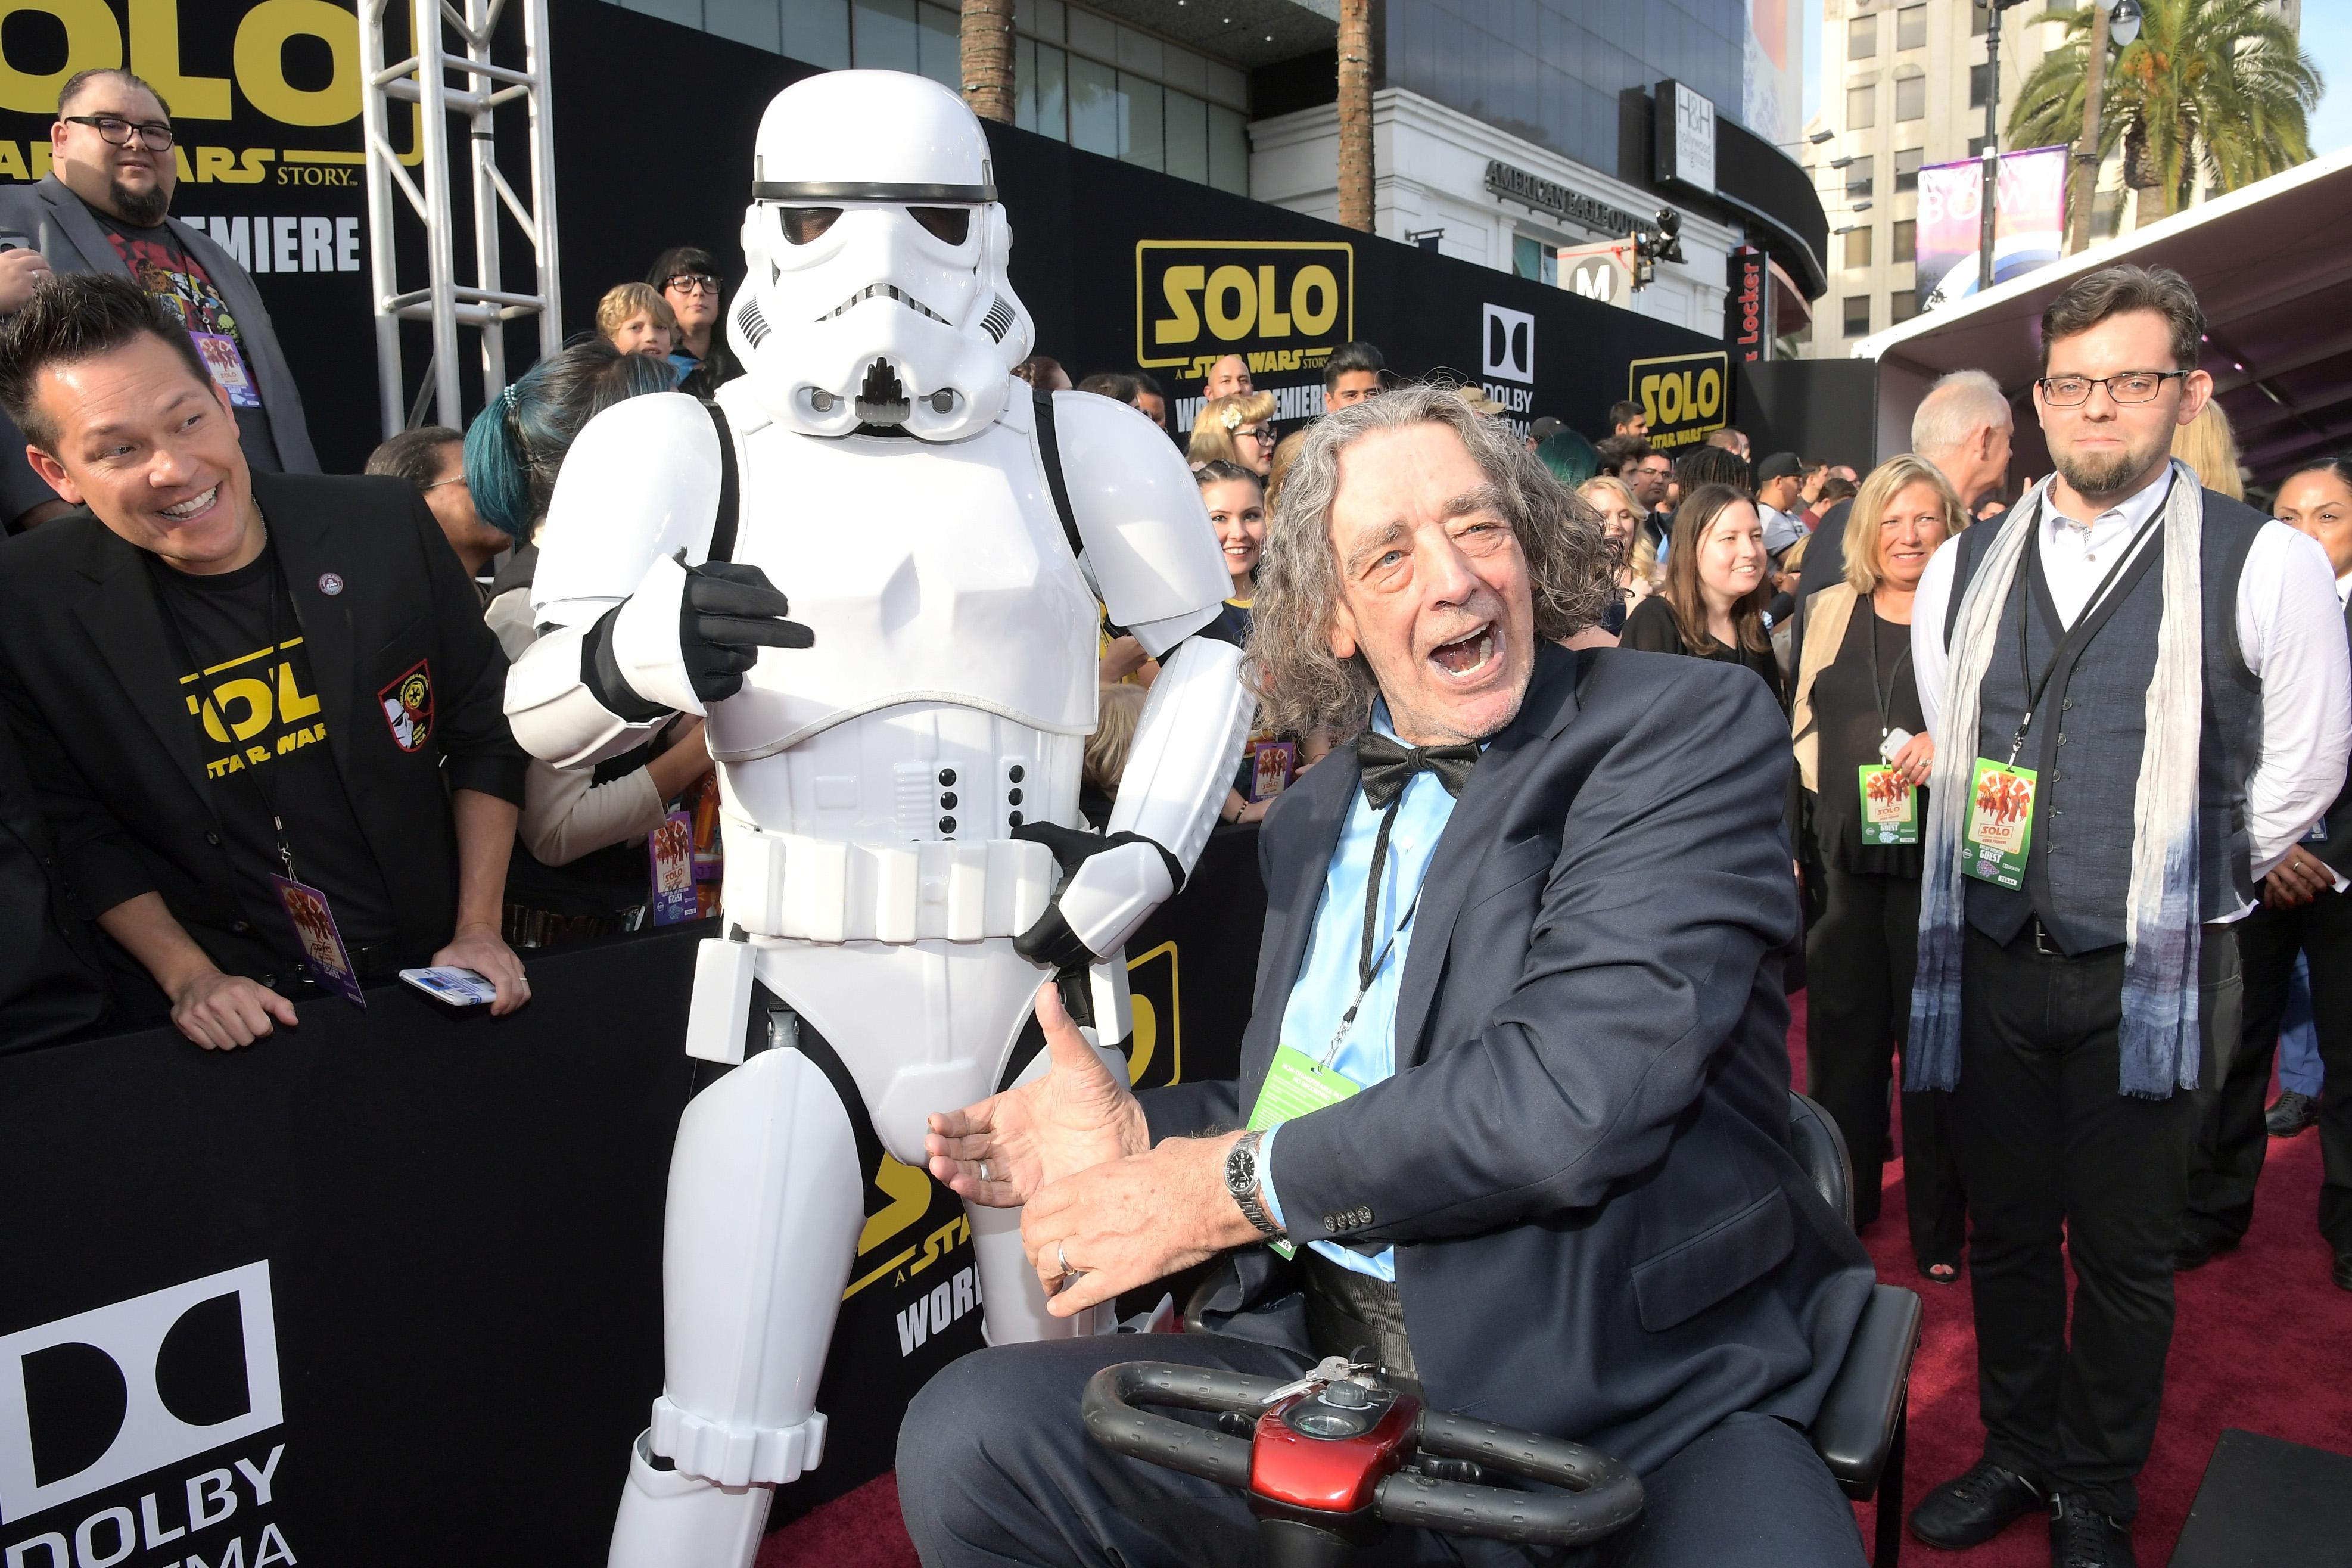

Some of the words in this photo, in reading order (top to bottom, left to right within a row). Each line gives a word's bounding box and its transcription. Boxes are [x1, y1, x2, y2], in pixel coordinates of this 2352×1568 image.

[1678, 88, 1710, 139] H&H
[278, 167, 353, 186] STORY
[1490, 163, 1564, 211] AMERICAN
[180, 216, 360, 273] MIERE
[1576, 265, 1609, 301] M
[1155, 265, 1338, 344] SOLO
[1737, 262, 1759, 344] Locker
[1175, 369, 1183, 380] A
[1247, 349, 1303, 374] WARS
[1641, 368, 1721, 428] SOLO
[1651, 433, 1676, 449] STAR
[1676, 426, 1703, 445] WARS
[1262, 781, 1278, 789] SOLO
[1877, 807, 1900, 816] SOLO
[1981, 826, 2011, 836] SOLO
[1979, 849, 2002, 864] GUEST
[665, 868, 683, 883] SOLO
[894, 1269, 906, 1287] A
